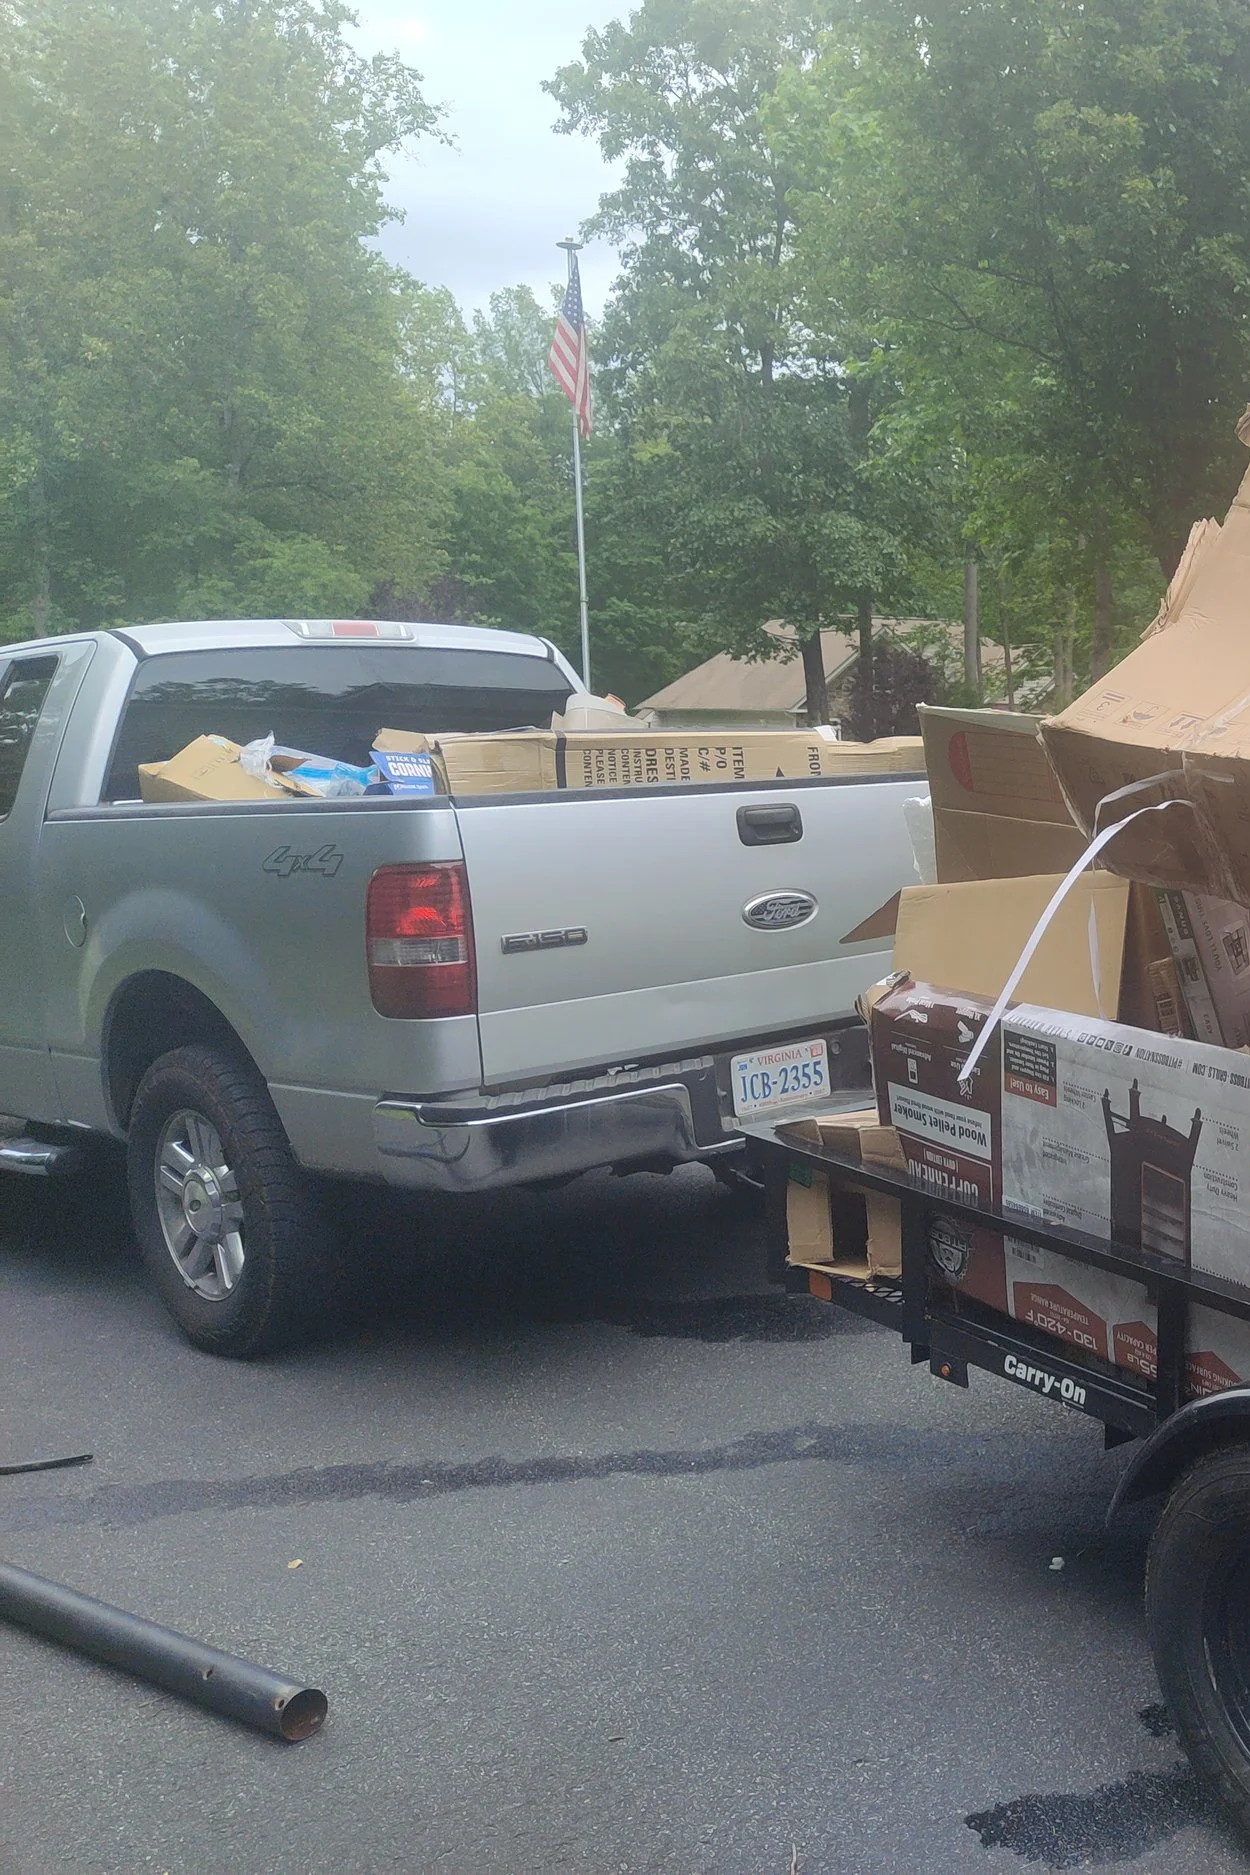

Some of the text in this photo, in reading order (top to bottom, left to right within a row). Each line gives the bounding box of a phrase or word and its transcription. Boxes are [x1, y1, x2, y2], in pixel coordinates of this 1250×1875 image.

[594, 748, 605, 785] PLEASE
[607, 748, 618, 783] NOTICE
[632, 747, 644, 784] INSTRU
[644, 748, 659, 783] DRES
[664, 747, 676, 781] DESTI
[678, 747, 690, 781] MADE
[698, 747, 711, 773] C/#
[715, 746, 728, 769] P/O
[731, 746, 745, 780] ITEM
[261, 843, 345, 878] 4x4
[763, 896, 803, 921] Ford
[757, 1048, 803, 1067] VIRGINIA
[740, 1059, 824, 1104] JCB-2355
[1009, 1077, 1049, 1101] Easy to Use!
[893, 1102, 987, 1148] Wood Pellet Smoker
[1203, 1172, 1239, 1192] Construction
[1206, 1182, 1239, 1203] Heavy Duty
[1047, 1299, 1090, 1327] TEMPERATURE
[1116, 1331, 1143, 1351] CAPACITY
[1003, 1353, 1087, 1405] Carry-On
